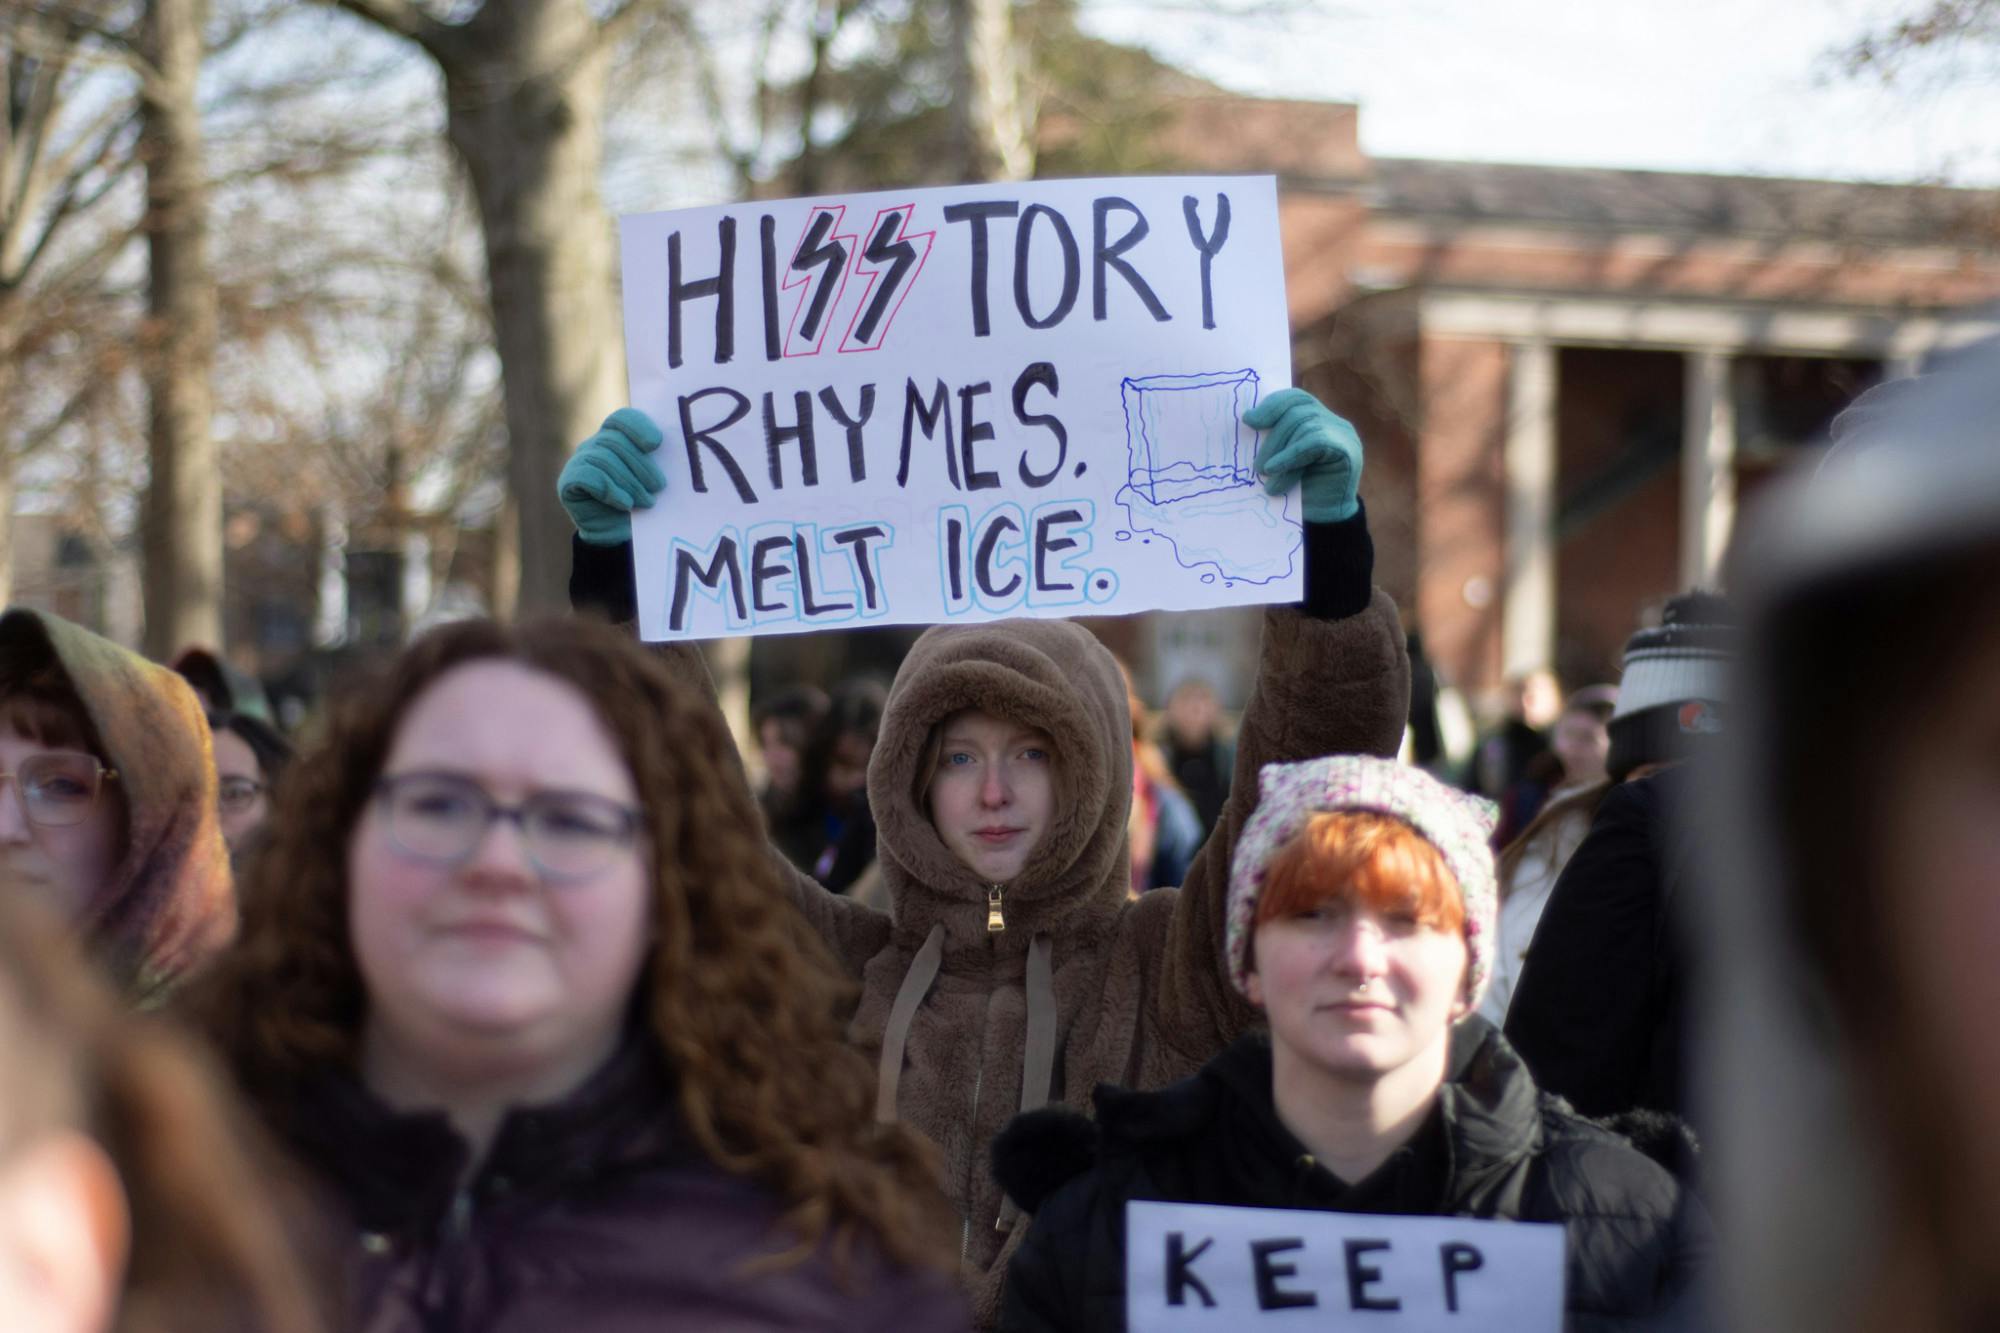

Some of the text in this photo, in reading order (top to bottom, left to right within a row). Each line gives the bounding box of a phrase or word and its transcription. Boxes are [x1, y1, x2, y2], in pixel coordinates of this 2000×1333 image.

[678, 362, 1087, 503] RHYMES.
[667, 503, 1117, 633] MELT ICE.
[1165, 1232, 1486, 1313] KEEP
